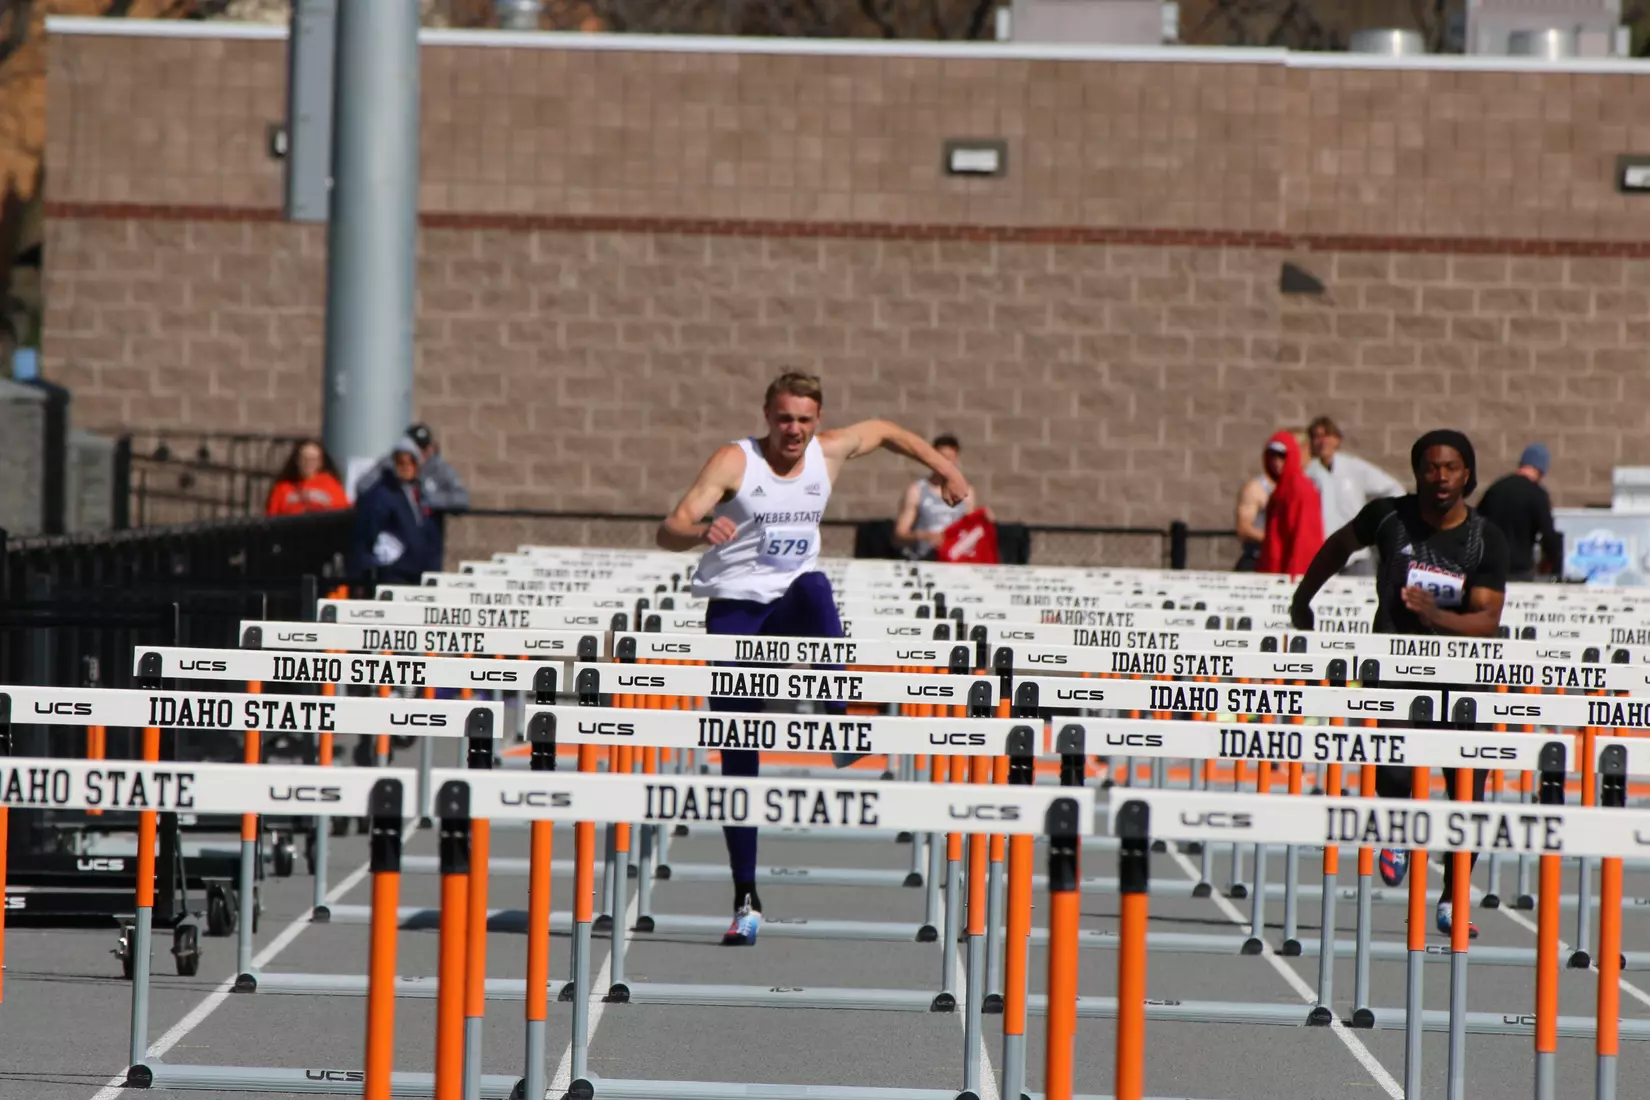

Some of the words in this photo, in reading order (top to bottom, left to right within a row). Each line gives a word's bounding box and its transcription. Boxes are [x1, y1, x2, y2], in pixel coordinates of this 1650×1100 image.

[754, 511, 791, 524] WEBER
[794, 511, 821, 523] STATE
[767, 539, 809, 556] 579
[424, 607, 471, 625] IDAHO
[478, 609, 529, 628] STATE
[1041, 609, 1083, 625] IDAHO
[1087, 612, 1134, 627] STATE
[278, 633, 317, 642] UCS
[363, 629, 417, 651] IDAHO
[425, 631, 484, 652] STATE
[525, 640, 564, 649] UCS
[1000, 631, 1034, 640] UCS
[1074, 629, 1120, 647] IDAHO
[1127, 631, 1179, 650] STATE
[1390, 639, 1440, 656] IDAHO
[1448, 642, 1503, 659] STATE
[1536, 650, 1571, 659] UCS
[652, 643, 691, 653] UCS
[735, 640, 789, 661] IDAHO
[797, 642, 856, 663] STATE
[180, 660, 226, 671] UCS
[273, 657, 341, 682] IDAHO
[351, 660, 426, 685] STATE
[471, 671, 517, 682] UCS
[1028, 654, 1067, 664] UCS
[1112, 652, 1166, 673] IDAHO
[1174, 655, 1233, 676] STATE
[1396, 666, 1436, 675] UCS
[1476, 663, 1533, 685] IDAHO
[1542, 666, 1606, 688] STATE
[618, 676, 665, 687] UCS
[711, 672, 779, 697] IDAHO
[788, 675, 862, 700] STATE
[907, 686, 953, 696] UCS
[1058, 690, 1104, 700] UCS
[1150, 686, 1218, 711] IDAHO
[1228, 689, 1302, 714] STATE
[1348, 700, 1394, 711] UCS
[1494, 705, 1541, 716] UCS
[35, 702, 92, 715] UCS
[149, 697, 232, 727] IDAHO
[245, 700, 335, 731] STATE
[390, 714, 447, 726] UCS
[578, 722, 634, 735] UCS
[698, 718, 776, 749] IDAHO
[787, 721, 871, 751] STATE
[930, 733, 985, 745] UCS
[1107, 734, 1162, 747] UCS
[1220, 729, 1302, 759] IDAHO
[1314, 733, 1405, 763] STATE
[1460, 747, 1517, 759] UCS
[0, 768, 70, 804] AHO
[85, 770, 194, 809] STATE
[270, 787, 341, 802] UCS
[501, 792, 572, 807] UCS
[645, 785, 748, 822] IDAHO
[765, 788, 879, 826] STATE
[949, 805, 1020, 821] UCS
[1180, 812, 1252, 828] UCS
[1326, 807, 1430, 844] IDAHO
[1447, 812, 1563, 851] STATE
[77, 858, 124, 871] UCS
[1503, 1016, 1535, 1025] UC
[306, 1069, 364, 1082] UCS
